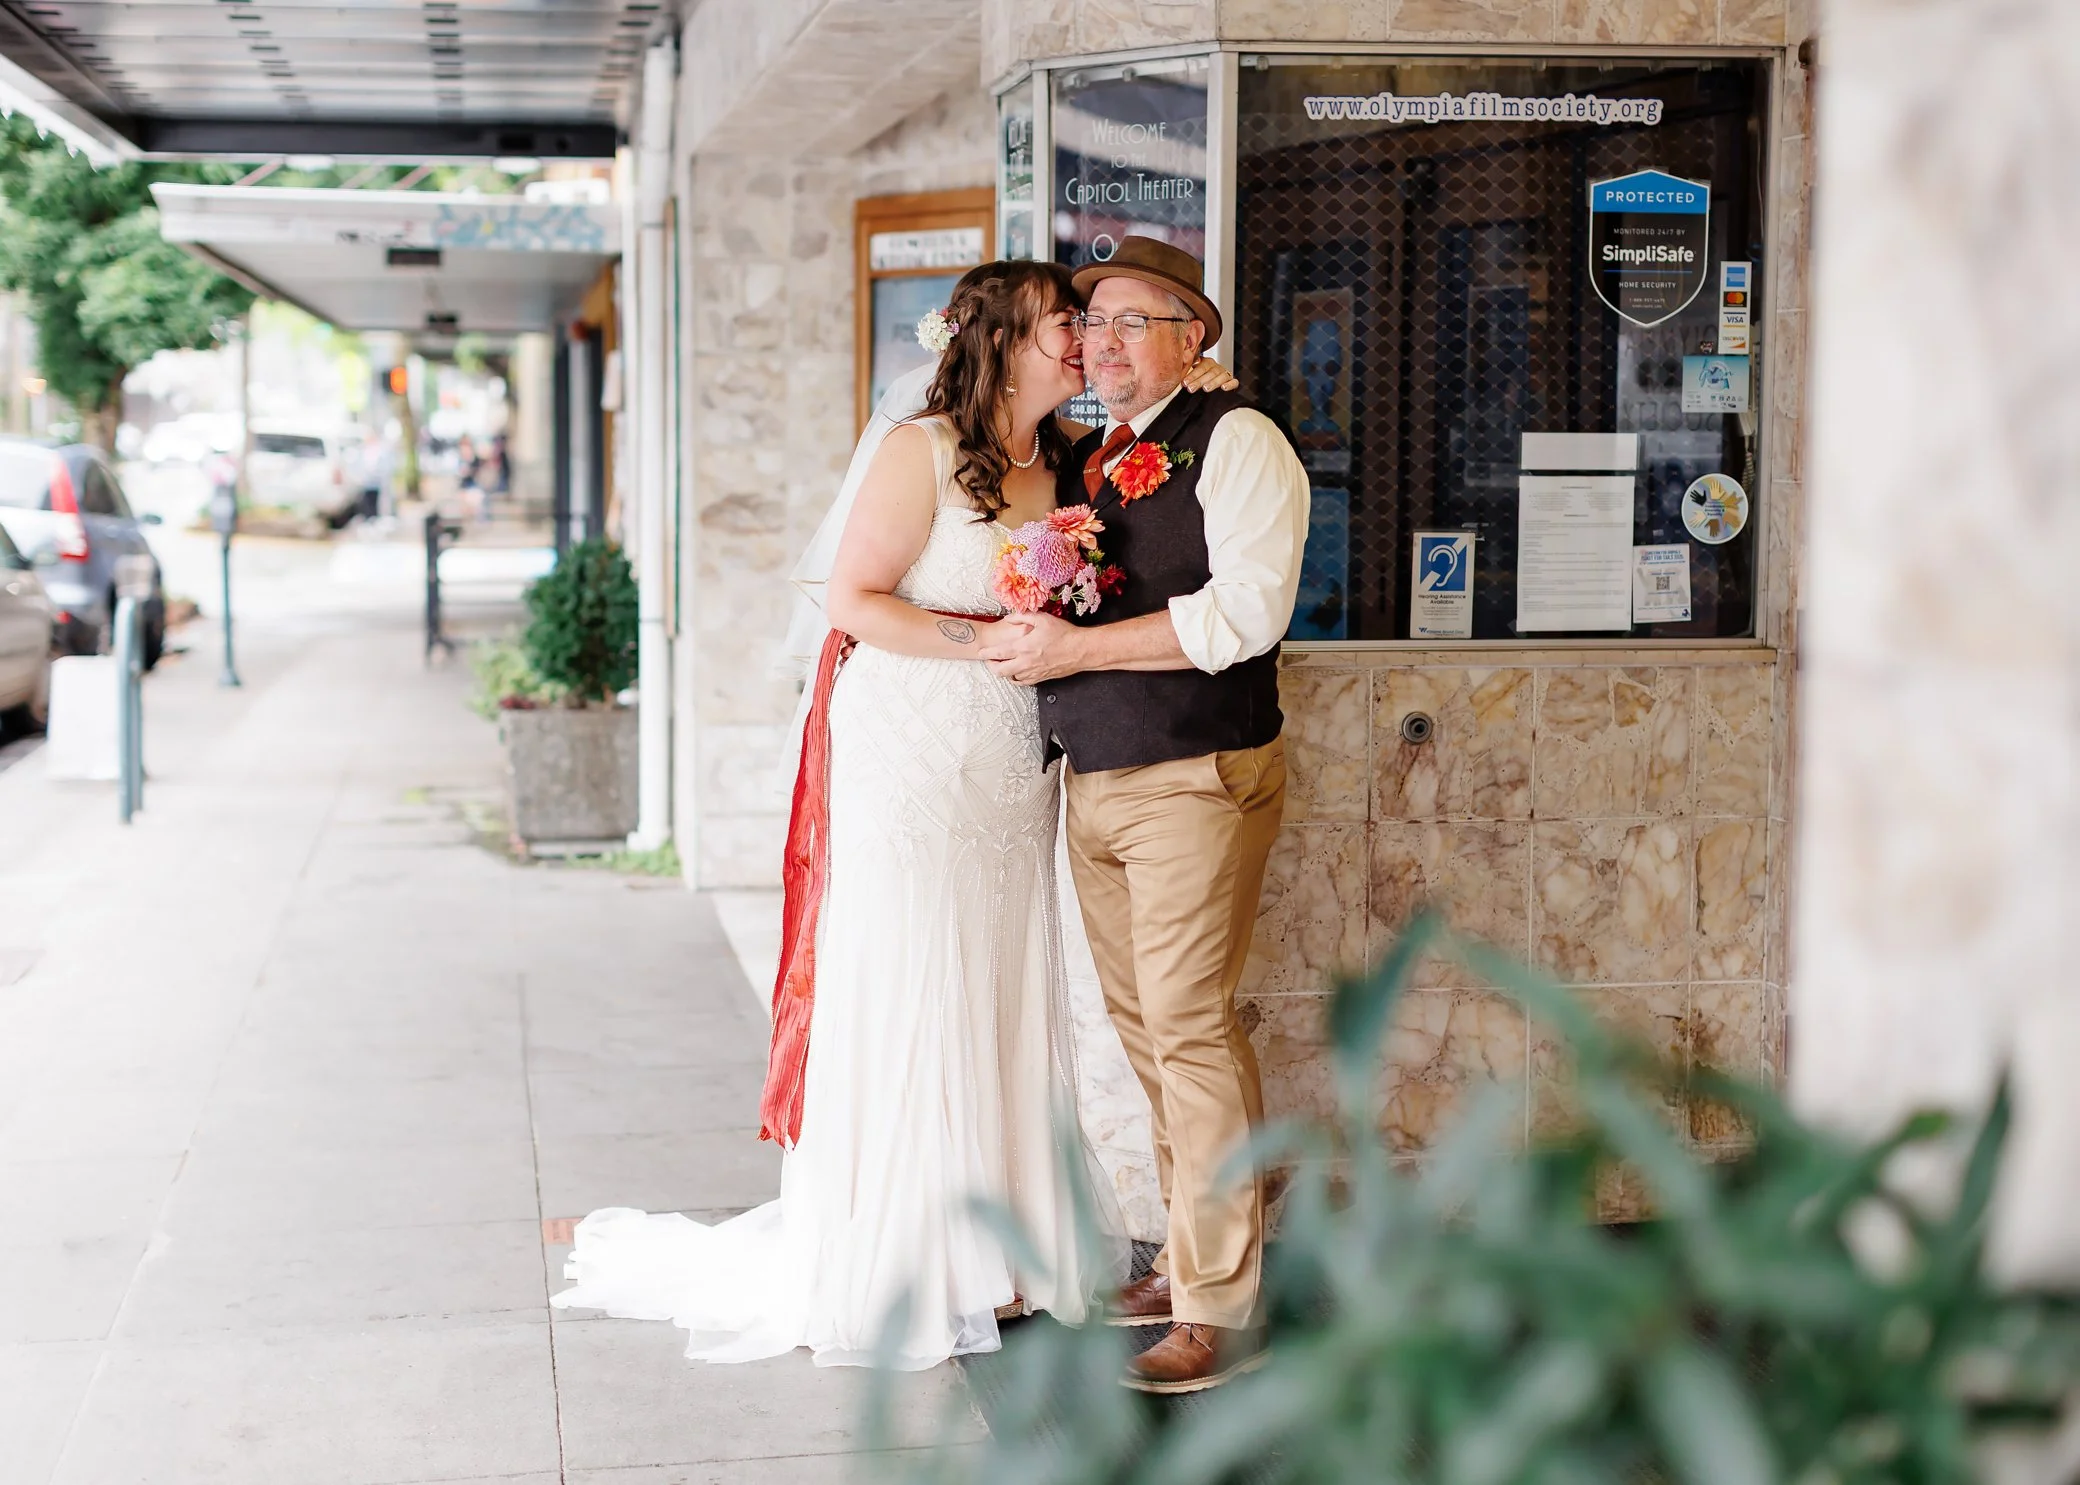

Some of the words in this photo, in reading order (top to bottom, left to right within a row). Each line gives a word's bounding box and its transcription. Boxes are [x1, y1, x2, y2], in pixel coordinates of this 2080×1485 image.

[1307, 96, 1659, 122] www.olympiafilmsociety.org
[1605, 190, 1695, 203] PROTECTED
[1613, 228, 1655, 236] MONITORED
[1602, 244, 1695, 265] SimpliSafe
[1070, 404, 1097, 416] $40.00
